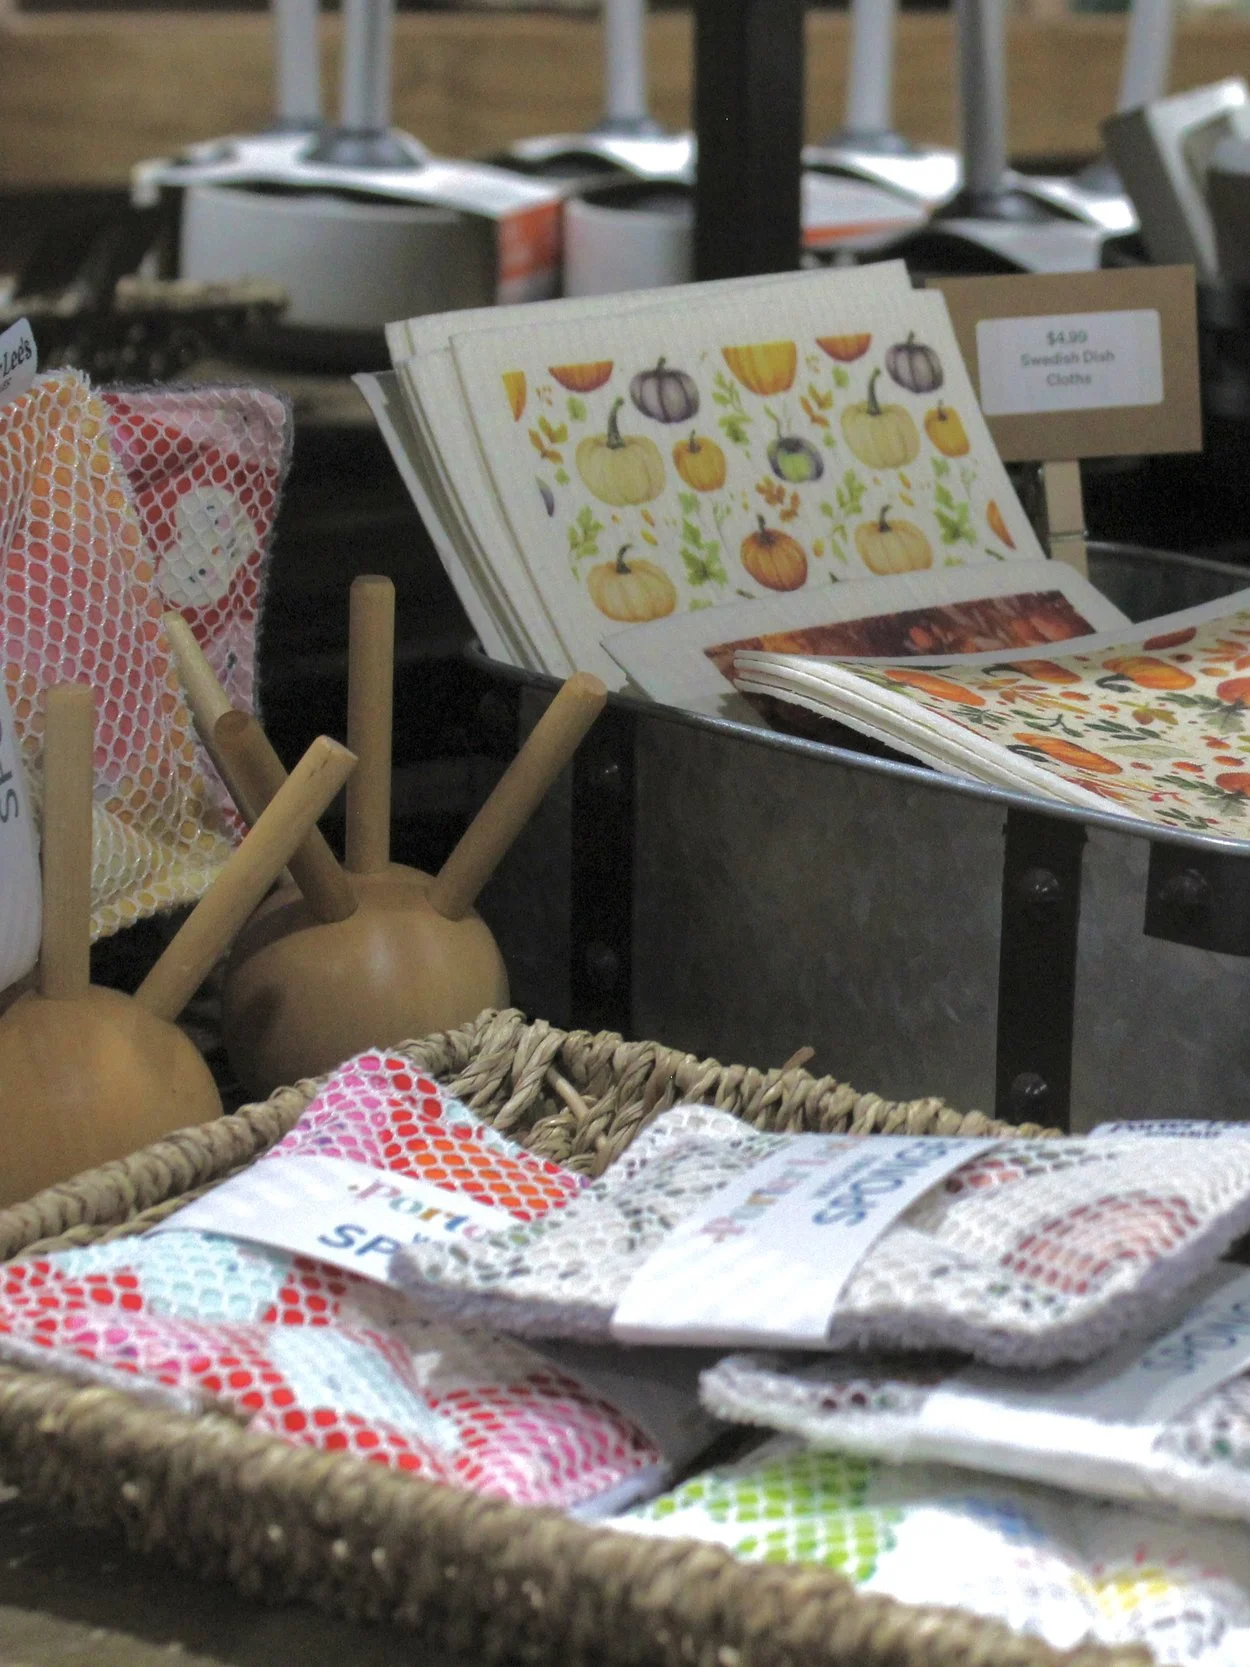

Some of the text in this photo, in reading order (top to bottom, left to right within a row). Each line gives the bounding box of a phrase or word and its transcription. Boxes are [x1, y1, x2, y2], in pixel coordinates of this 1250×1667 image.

[1046, 329, 1089, 346] $4.99
[1020, 350, 1115, 368] Swedish Dish
[1046, 372, 1092, 387] Cloths
